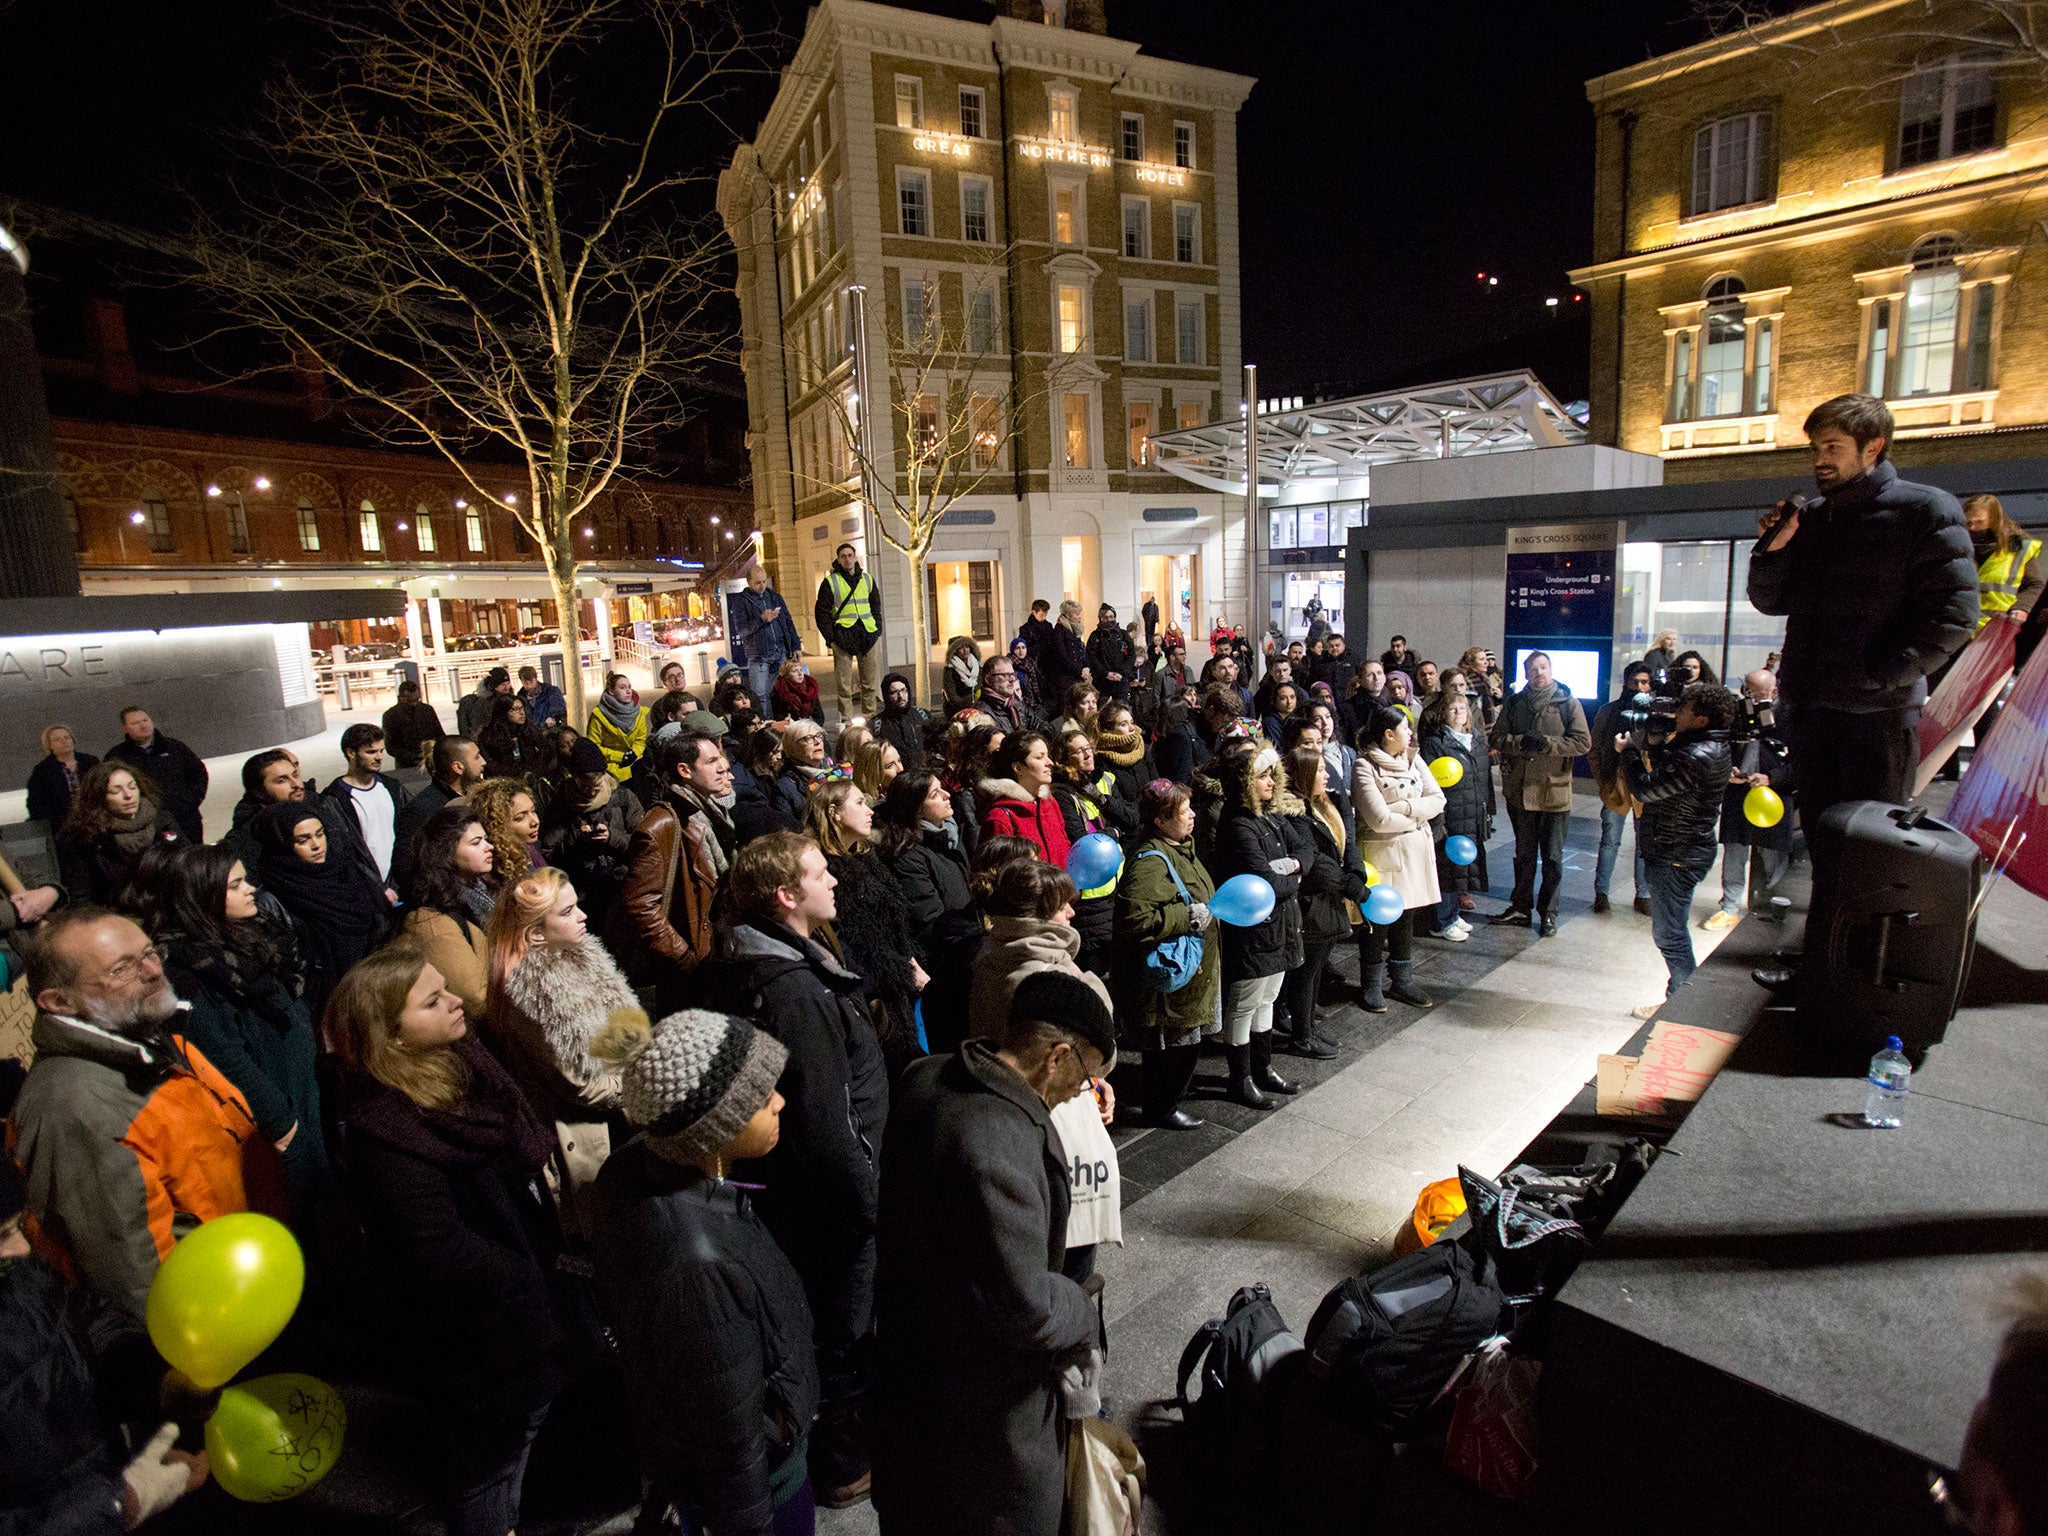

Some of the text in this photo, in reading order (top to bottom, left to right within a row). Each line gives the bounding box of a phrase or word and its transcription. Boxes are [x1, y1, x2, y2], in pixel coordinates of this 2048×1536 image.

[912, 138, 1186, 187] GREAT NORTHERN HOTEL
[1514, 533, 1608, 544] KING'S CROSS SQUARE
[1545, 576, 1589, 584] Underground
[1530, 588, 1549, 596] King's
[1570, 587, 1595, 595] Station
